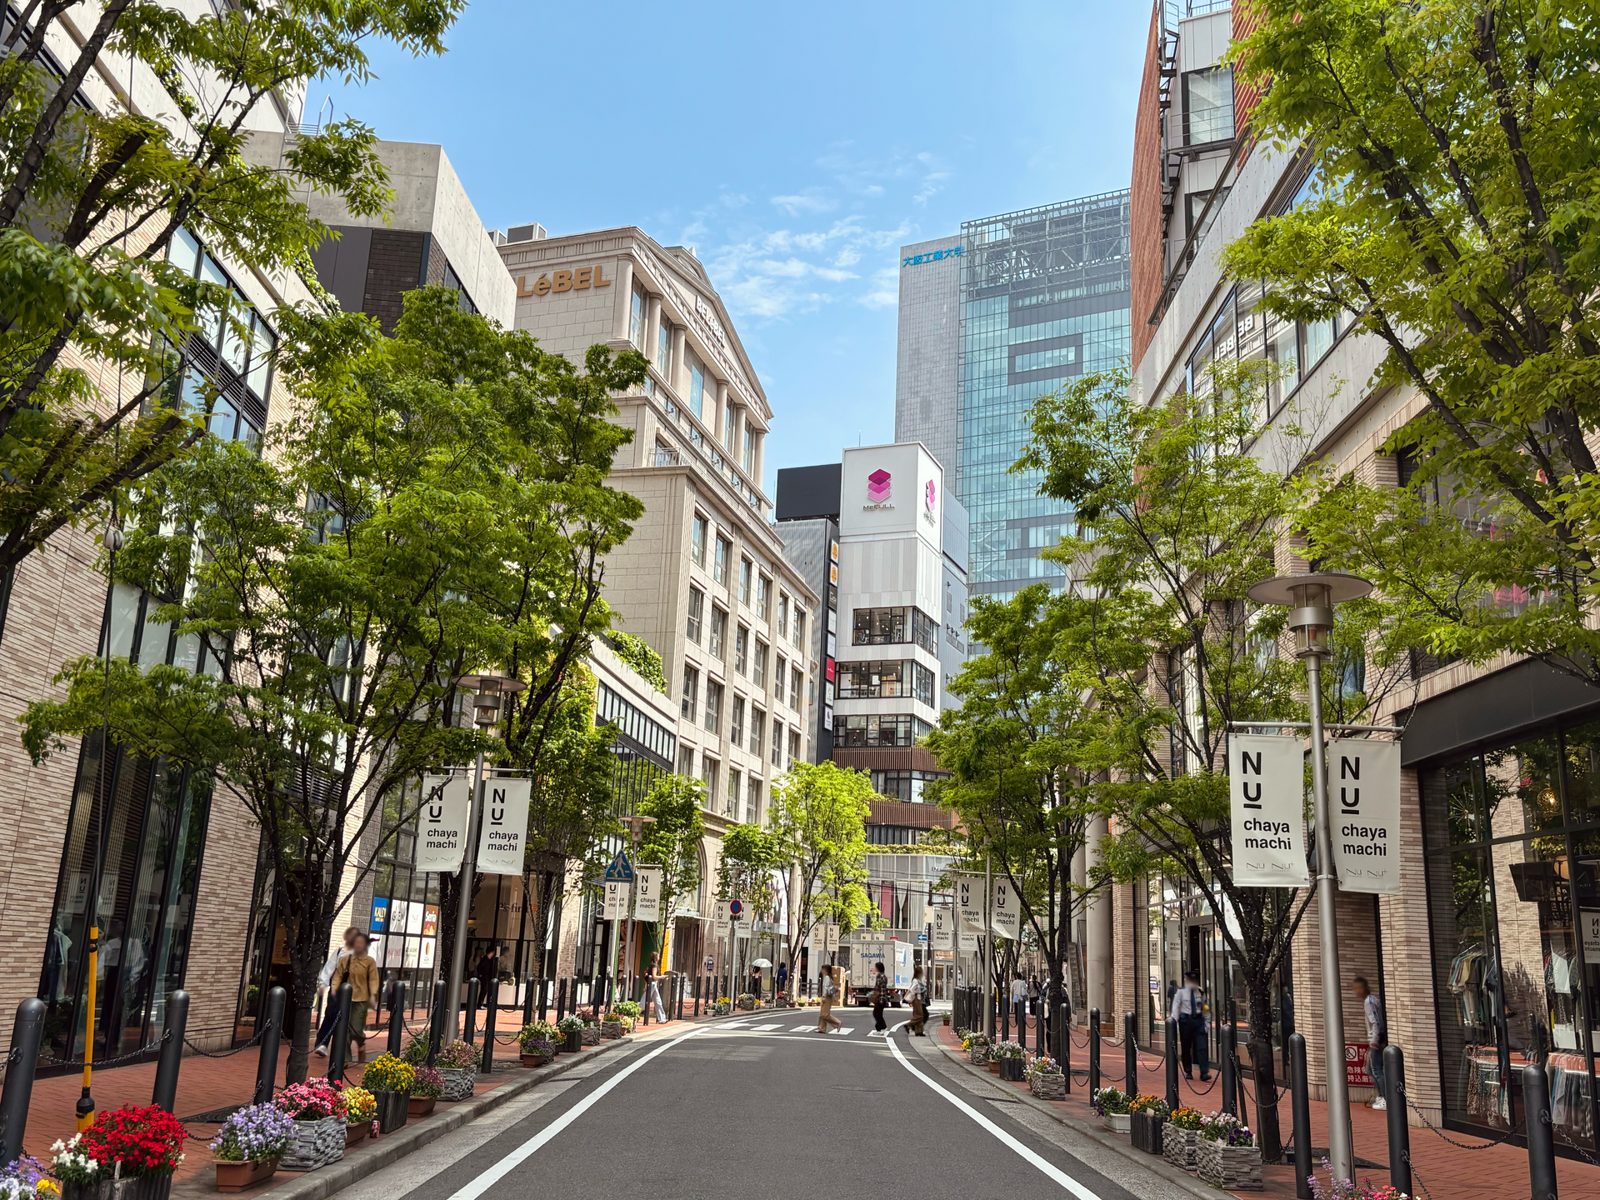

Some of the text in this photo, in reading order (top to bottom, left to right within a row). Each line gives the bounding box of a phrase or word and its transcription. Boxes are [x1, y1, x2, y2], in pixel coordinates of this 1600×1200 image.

[517, 264, 610, 297] LéBEL
[1243, 818, 1290, 835] chaya
[1341, 824, 1387, 841] chaya
[427, 828, 458, 839] chaya
[488, 831, 519, 842] chaya
[426, 840, 457, 848] machi
[487, 843, 518, 851] machi
[1245, 837, 1291, 850] machi
[1343, 843, 1387, 856] machi
[996, 912, 1015, 920] chaya
